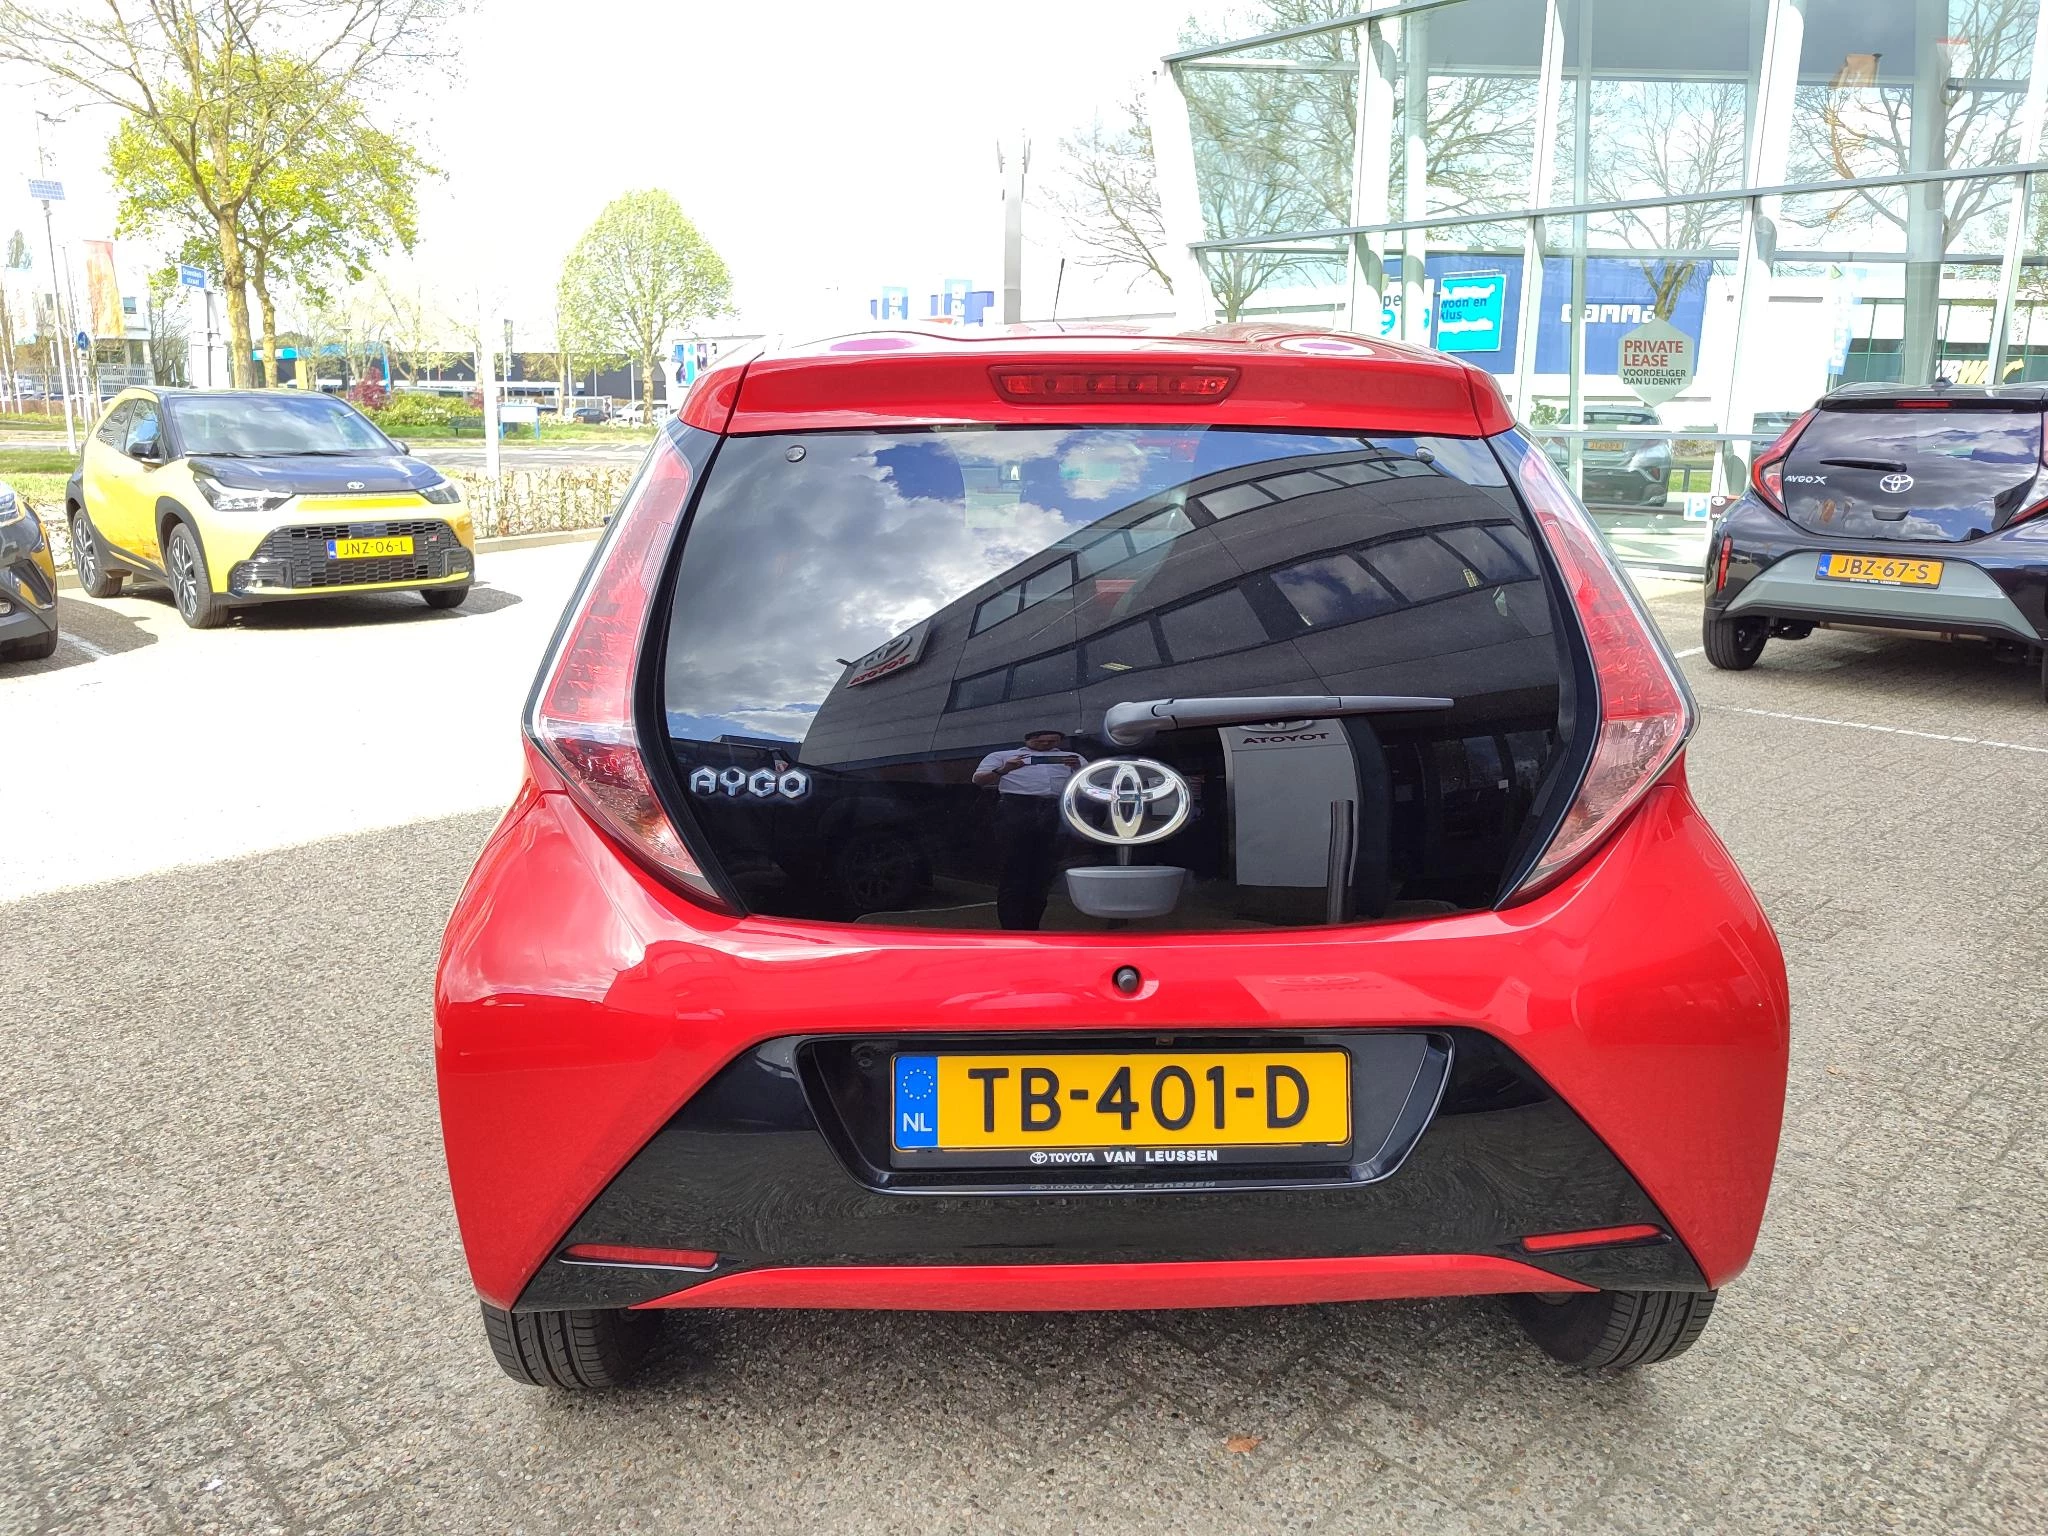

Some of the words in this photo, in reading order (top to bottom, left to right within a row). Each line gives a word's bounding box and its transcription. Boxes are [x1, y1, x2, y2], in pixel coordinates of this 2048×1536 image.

[1624, 340, 1684, 354] PRIVATE
[1623, 354, 1669, 367] LEASE
[1623, 368, 1686, 377] VOORDELIGER
[1623, 377, 1643, 385] DAN
[1652, 378, 1683, 386] DENKT
[1784, 475, 1814, 484] AYGO
[1813, 475, 1828, 486] X
[344, 540, 408, 556] JNZ-06-L
[1837, 558, 1930, 580] JBZ-67-S
[690, 767, 806, 799] AYGO
[967, 1064, 1310, 1133] TB-401-D
[902, 1112, 933, 1133] NL
[1049, 1152, 1096, 1163] TOYOTA
[1103, 1151, 1136, 1163] VAN
[1145, 1150, 1218, 1162] LEUSSEN
